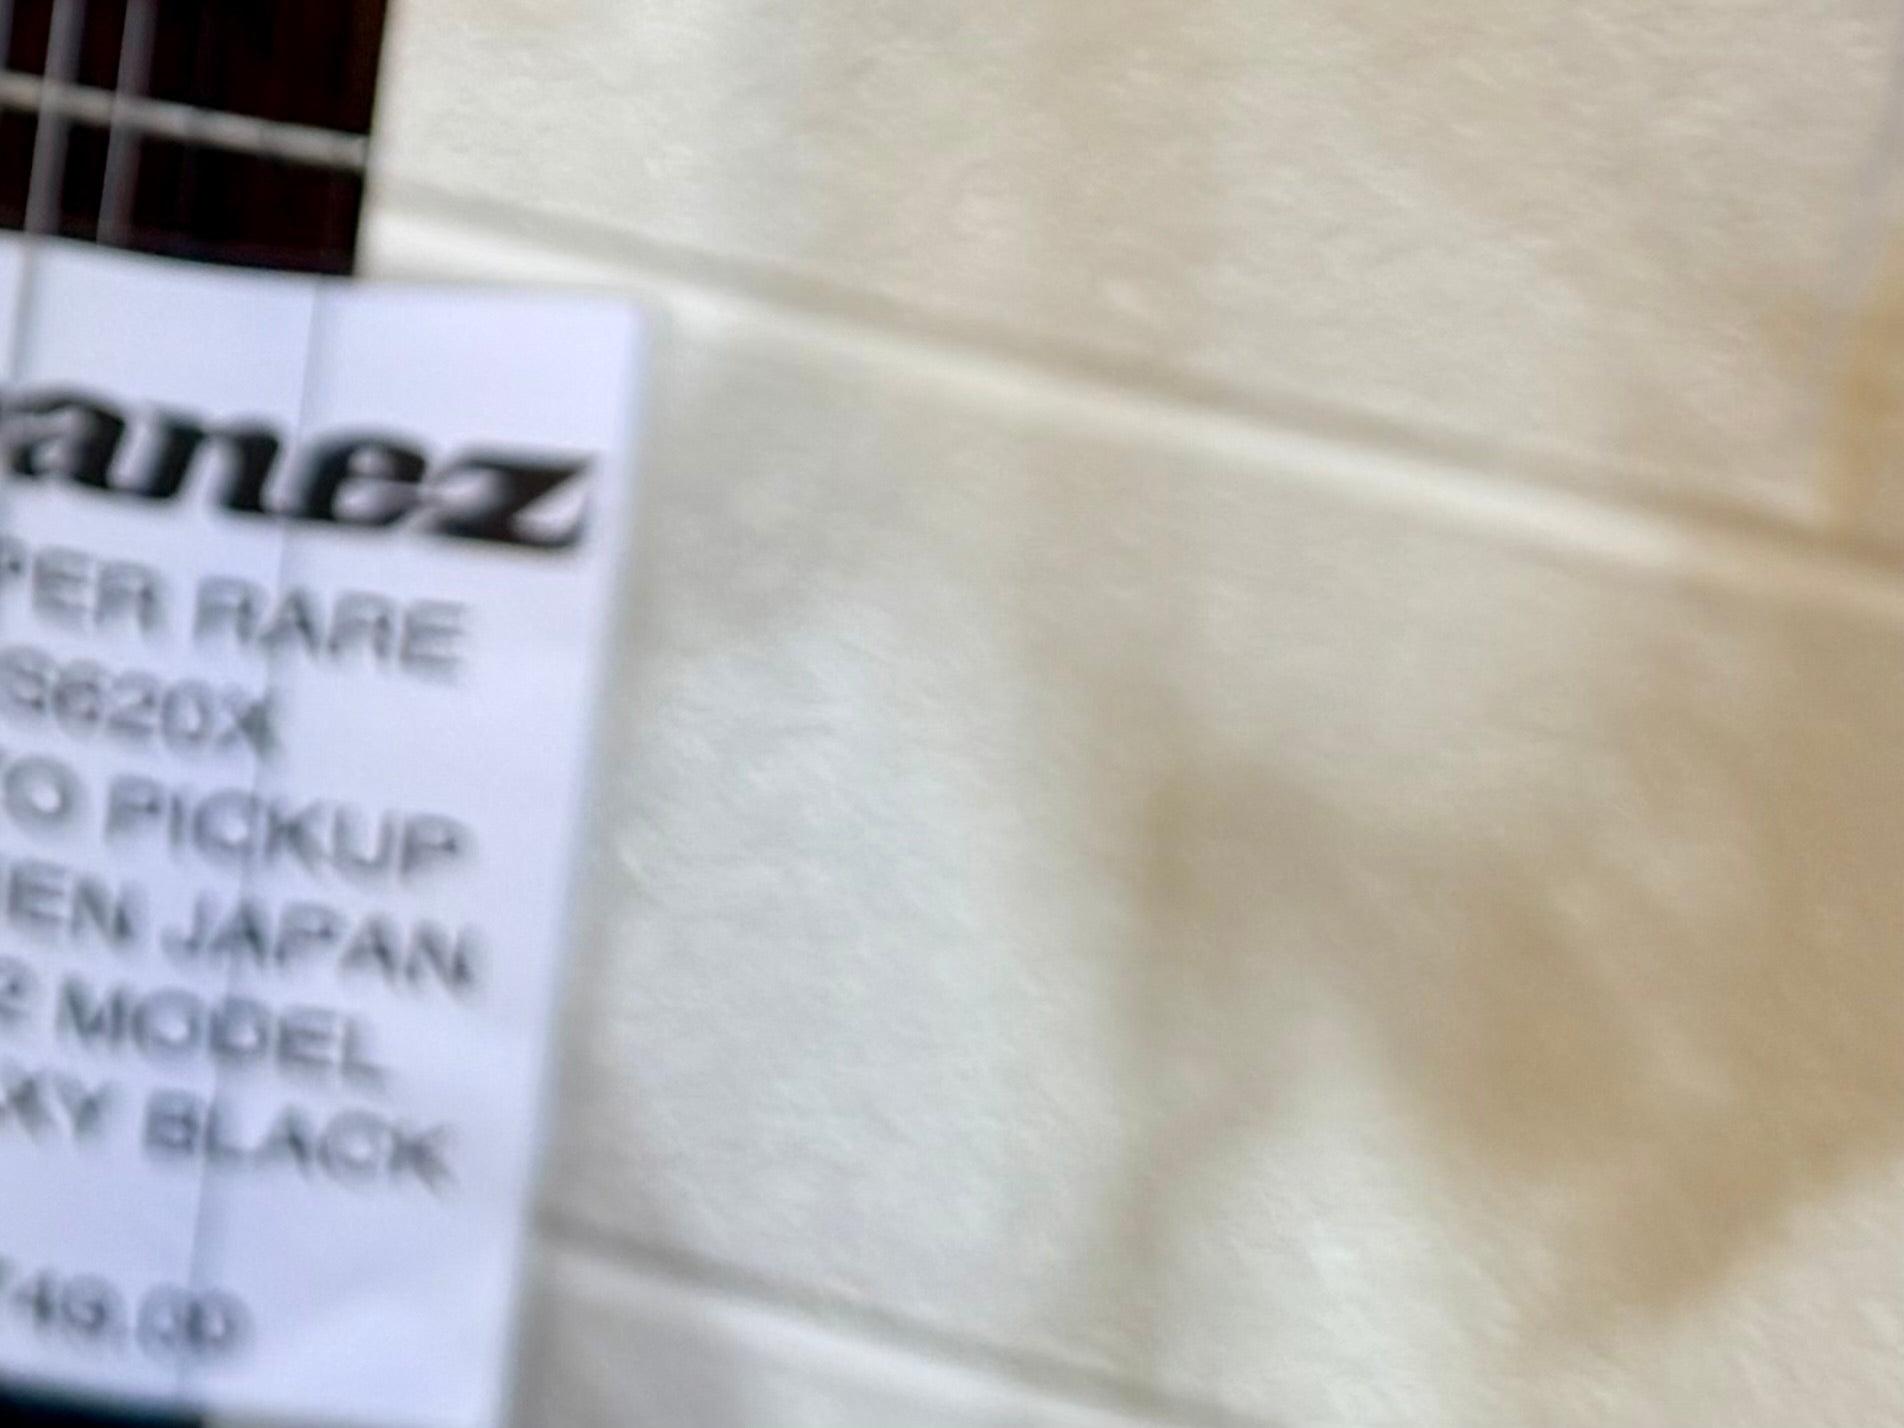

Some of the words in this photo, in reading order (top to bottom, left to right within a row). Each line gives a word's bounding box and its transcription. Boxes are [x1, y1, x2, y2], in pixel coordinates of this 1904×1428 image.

[192, 574, 467, 681] RARE
[104, 772, 476, 886] PICKUP
[158, 889, 492, 1002] JAPAN
[55, 972, 392, 1092] MODEL
[140, 1086, 460, 1196] BLACK
